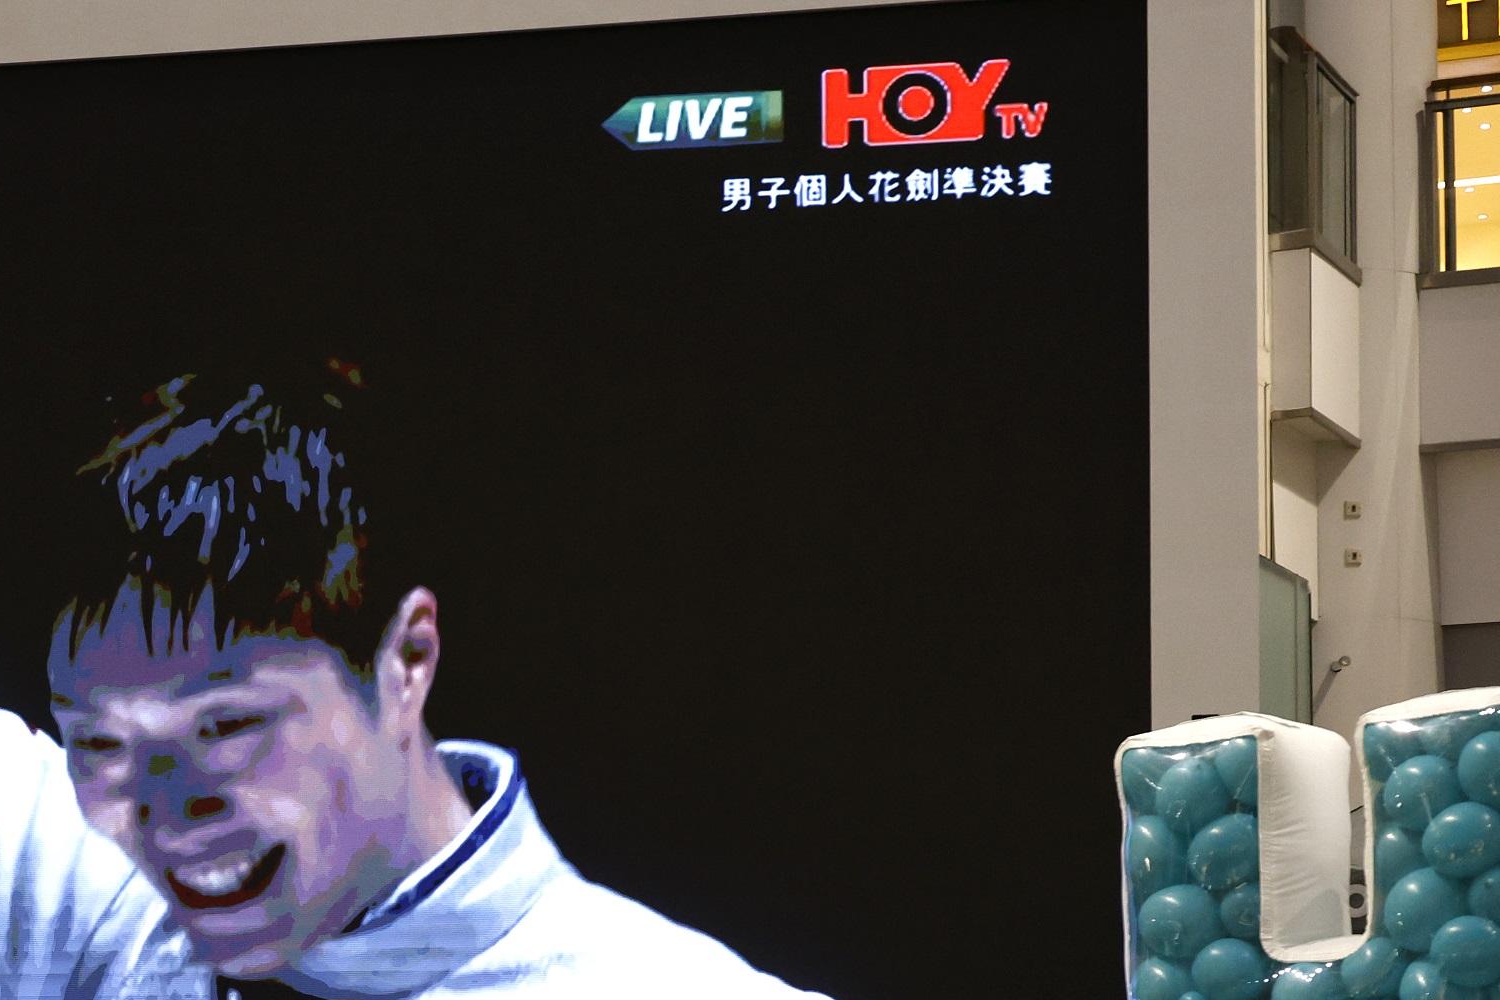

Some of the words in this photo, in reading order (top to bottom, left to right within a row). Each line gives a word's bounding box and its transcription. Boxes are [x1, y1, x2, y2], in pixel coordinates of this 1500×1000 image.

[635, 96, 754, 145] LIVE
[821, 58, 1011, 149] HOY
[995, 101, 1049, 140] TV
[720, 161, 1052, 212] 男子個人花劍準決賽
